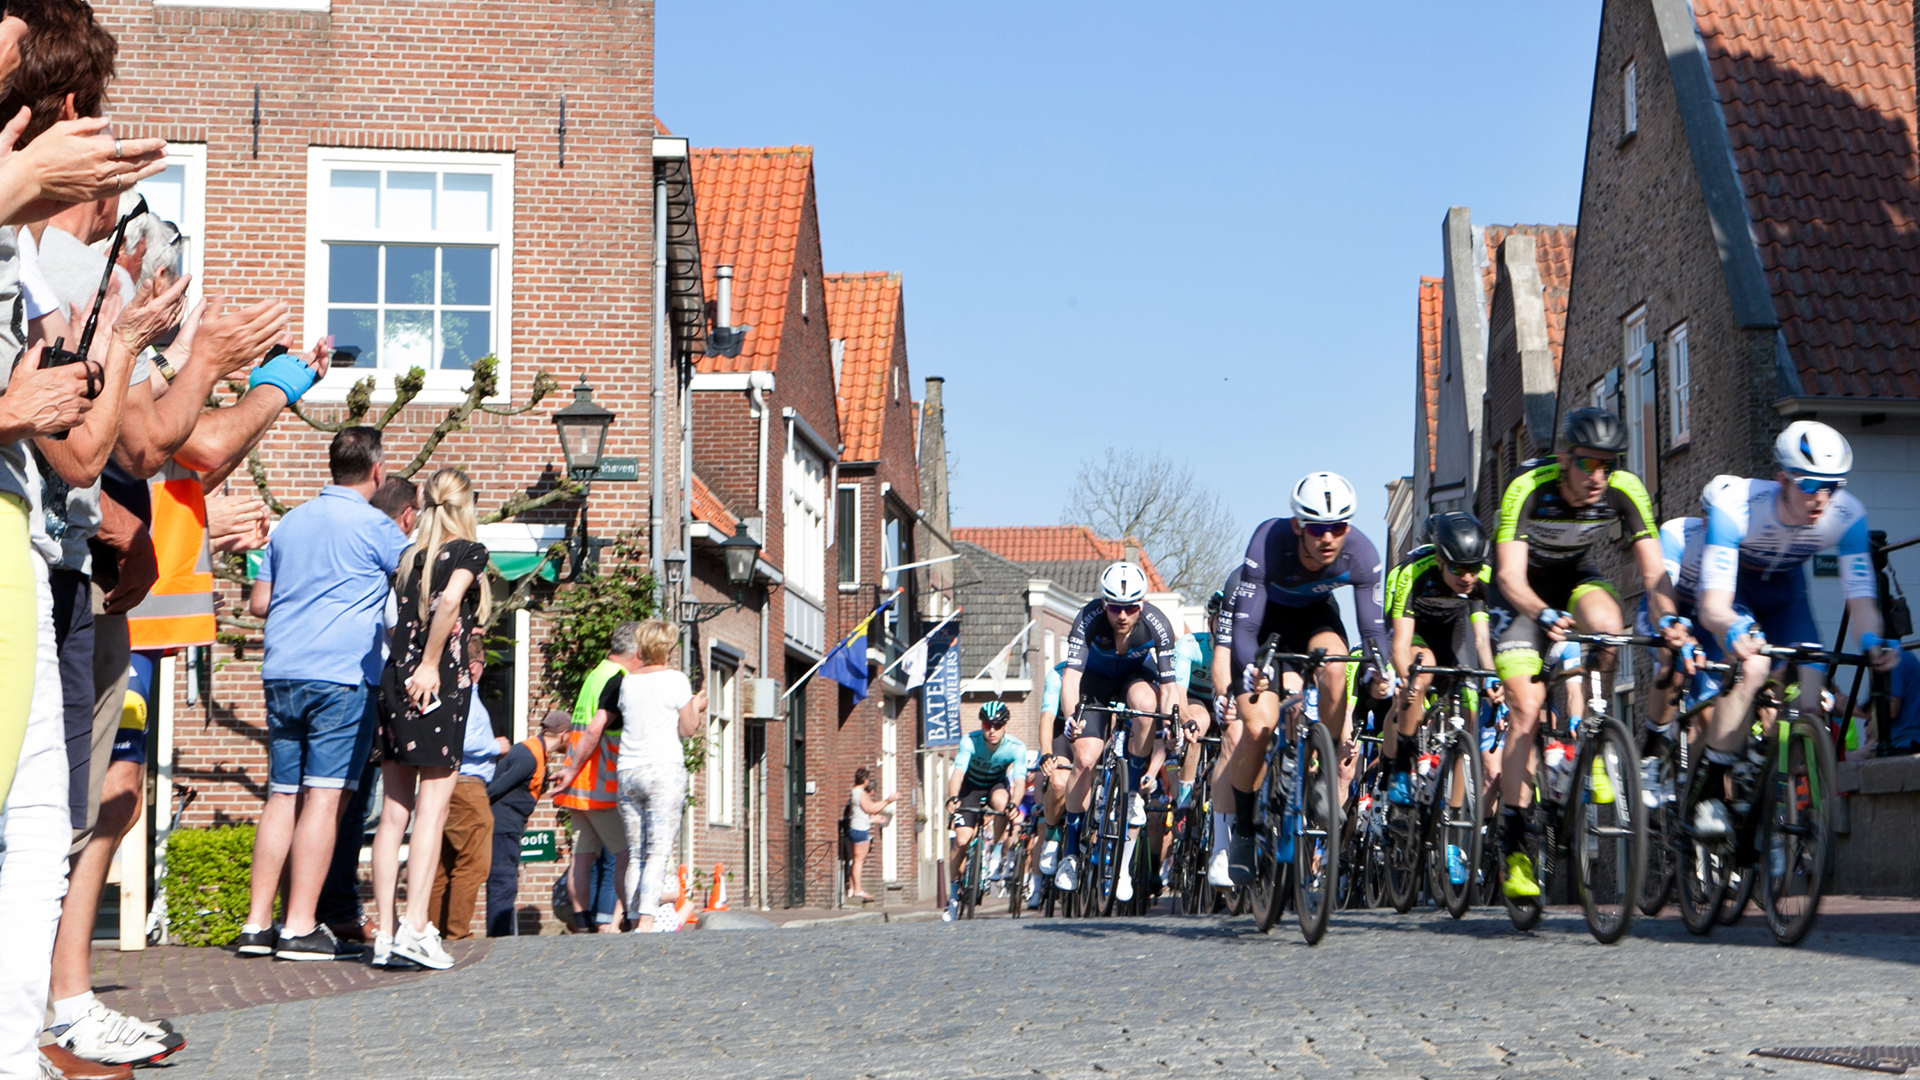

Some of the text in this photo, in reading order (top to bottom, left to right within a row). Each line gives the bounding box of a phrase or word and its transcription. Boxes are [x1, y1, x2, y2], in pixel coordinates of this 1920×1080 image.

[1077, 606, 1104, 635] EISBERG
[1146, 612, 1170, 646] EISBERG
[946, 651, 960, 740] TWEEWIELERS
